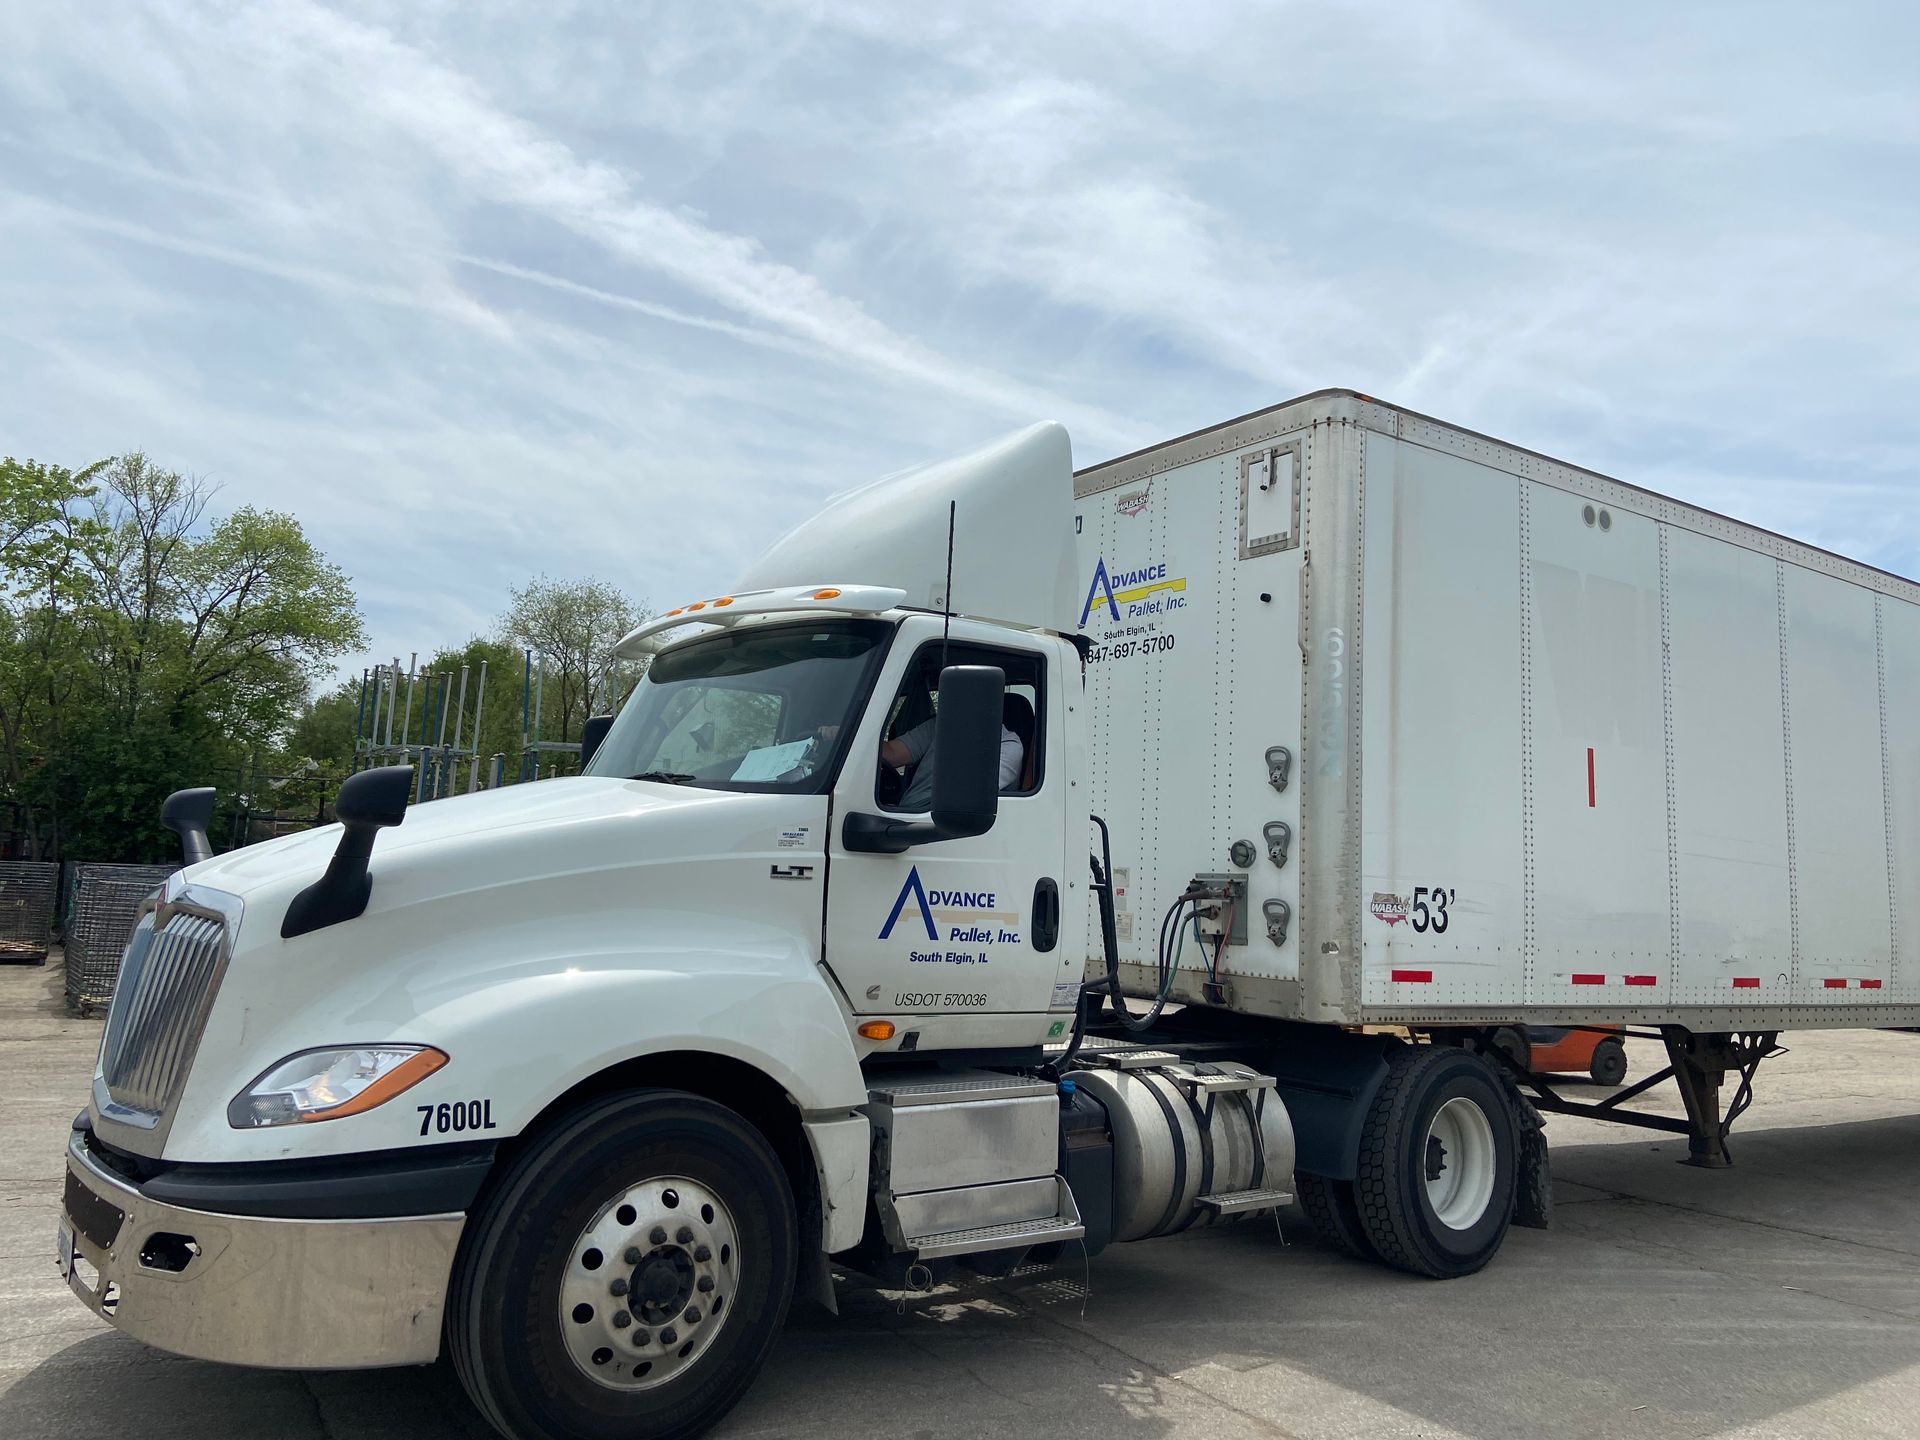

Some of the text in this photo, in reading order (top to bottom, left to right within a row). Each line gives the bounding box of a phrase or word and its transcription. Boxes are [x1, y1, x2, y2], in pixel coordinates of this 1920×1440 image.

[1117, 494, 1149, 512] WABASH
[1078, 556, 1166, 629] ADVANCE
[1128, 596, 1188, 619] Pallet, Inc.
[1104, 622, 1156, 641] South Elgin, IL
[1086, 634, 1175, 664] 847-697-5700
[771, 864, 813, 876] LT
[878, 864, 996, 941] ADVANCE
[1371, 903, 1408, 914] WABASH
[950, 927, 1021, 945] Pallet, Inc.
[910, 951, 988, 965] South Elgin, IL
[894, 993, 988, 1007] USDOT 570036
[416, 1099, 497, 1136] 7600L
